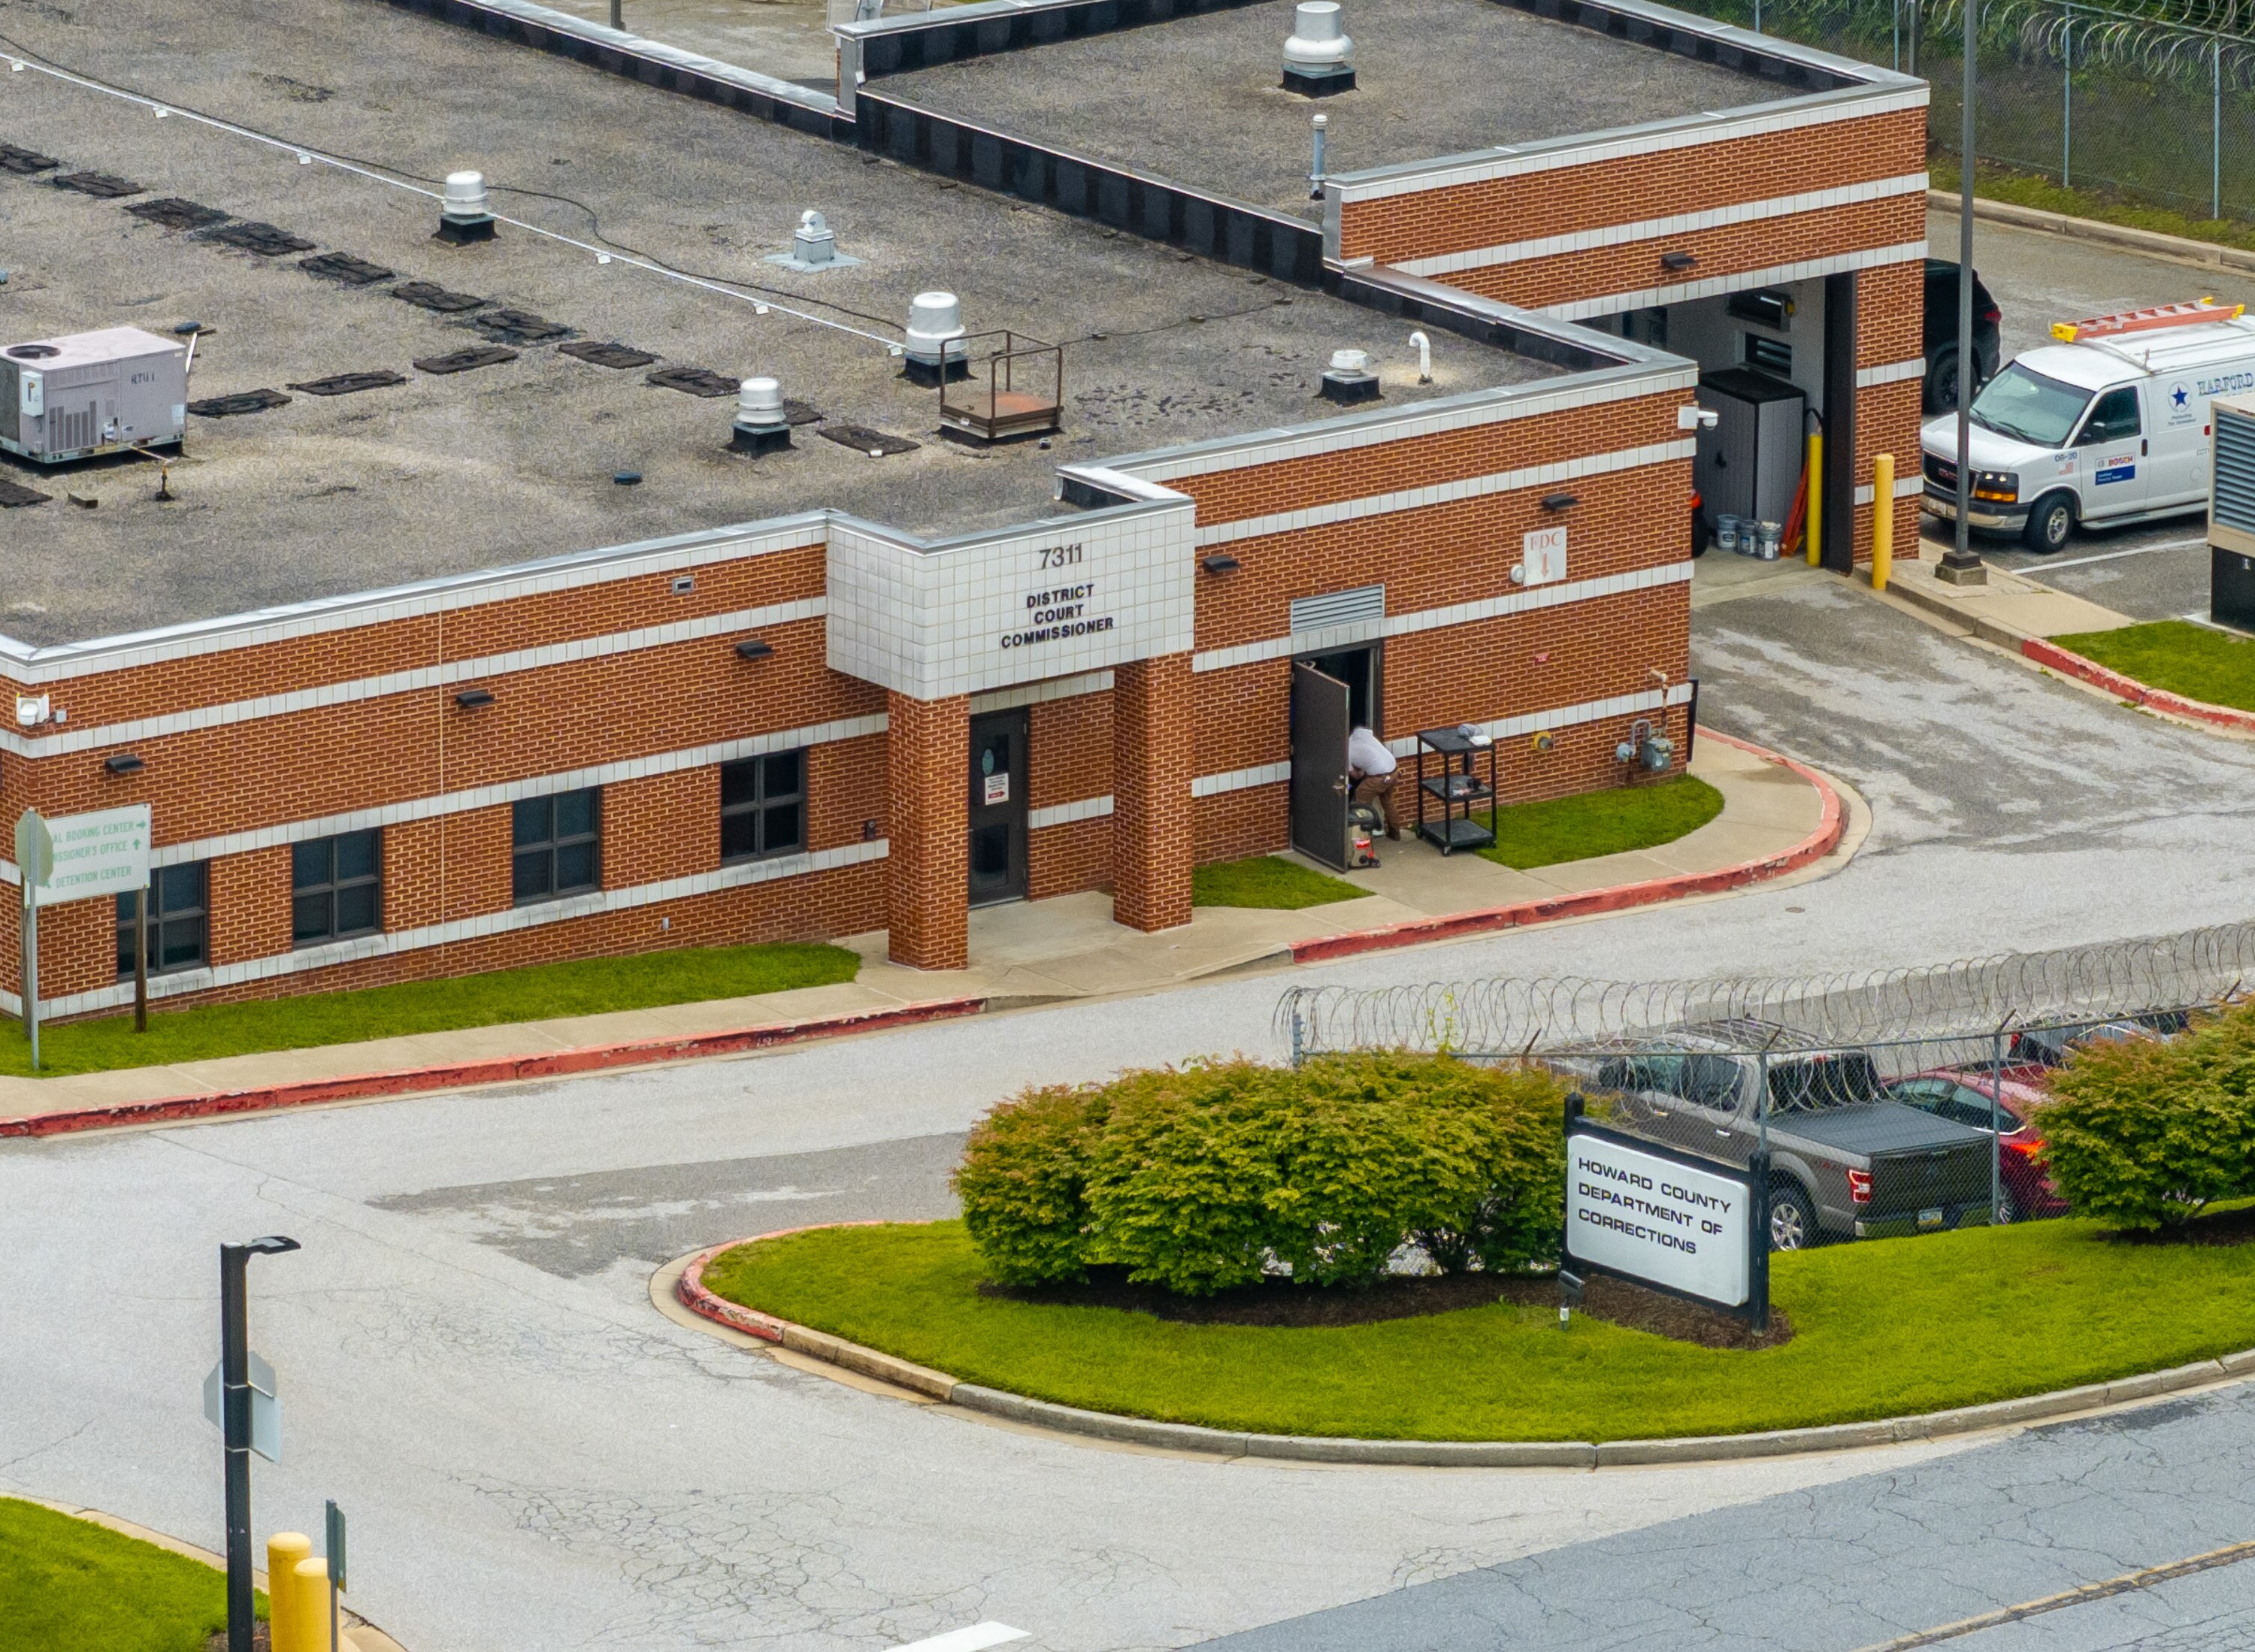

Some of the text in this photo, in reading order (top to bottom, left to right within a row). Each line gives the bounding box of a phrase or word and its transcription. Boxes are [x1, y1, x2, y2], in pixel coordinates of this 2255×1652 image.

[2197, 372, 2253, 396] HARFORD
[2108, 455, 2133, 467] BOSCH
[1530, 531, 1562, 550] FDC
[1040, 543, 1082, 570] 7311
[1027, 584, 1094, 608] DISTRICT
[1034, 604, 1084, 625] COURT
[1001, 618, 1113, 649] COMMISSIONER
[66, 826, 100, 842] BOOKING
[103, 821, 135, 835] CENTER
[100, 840, 128, 854] OFFICE
[56, 866, 132, 888] DETENTION CENTER
[1578, 1157, 1731, 1213] HOWARD COUNTY
[1578, 1182, 1723, 1235] DEPARTMENT OF
[1578, 1208, 1697, 1254] CORRECTIONS
